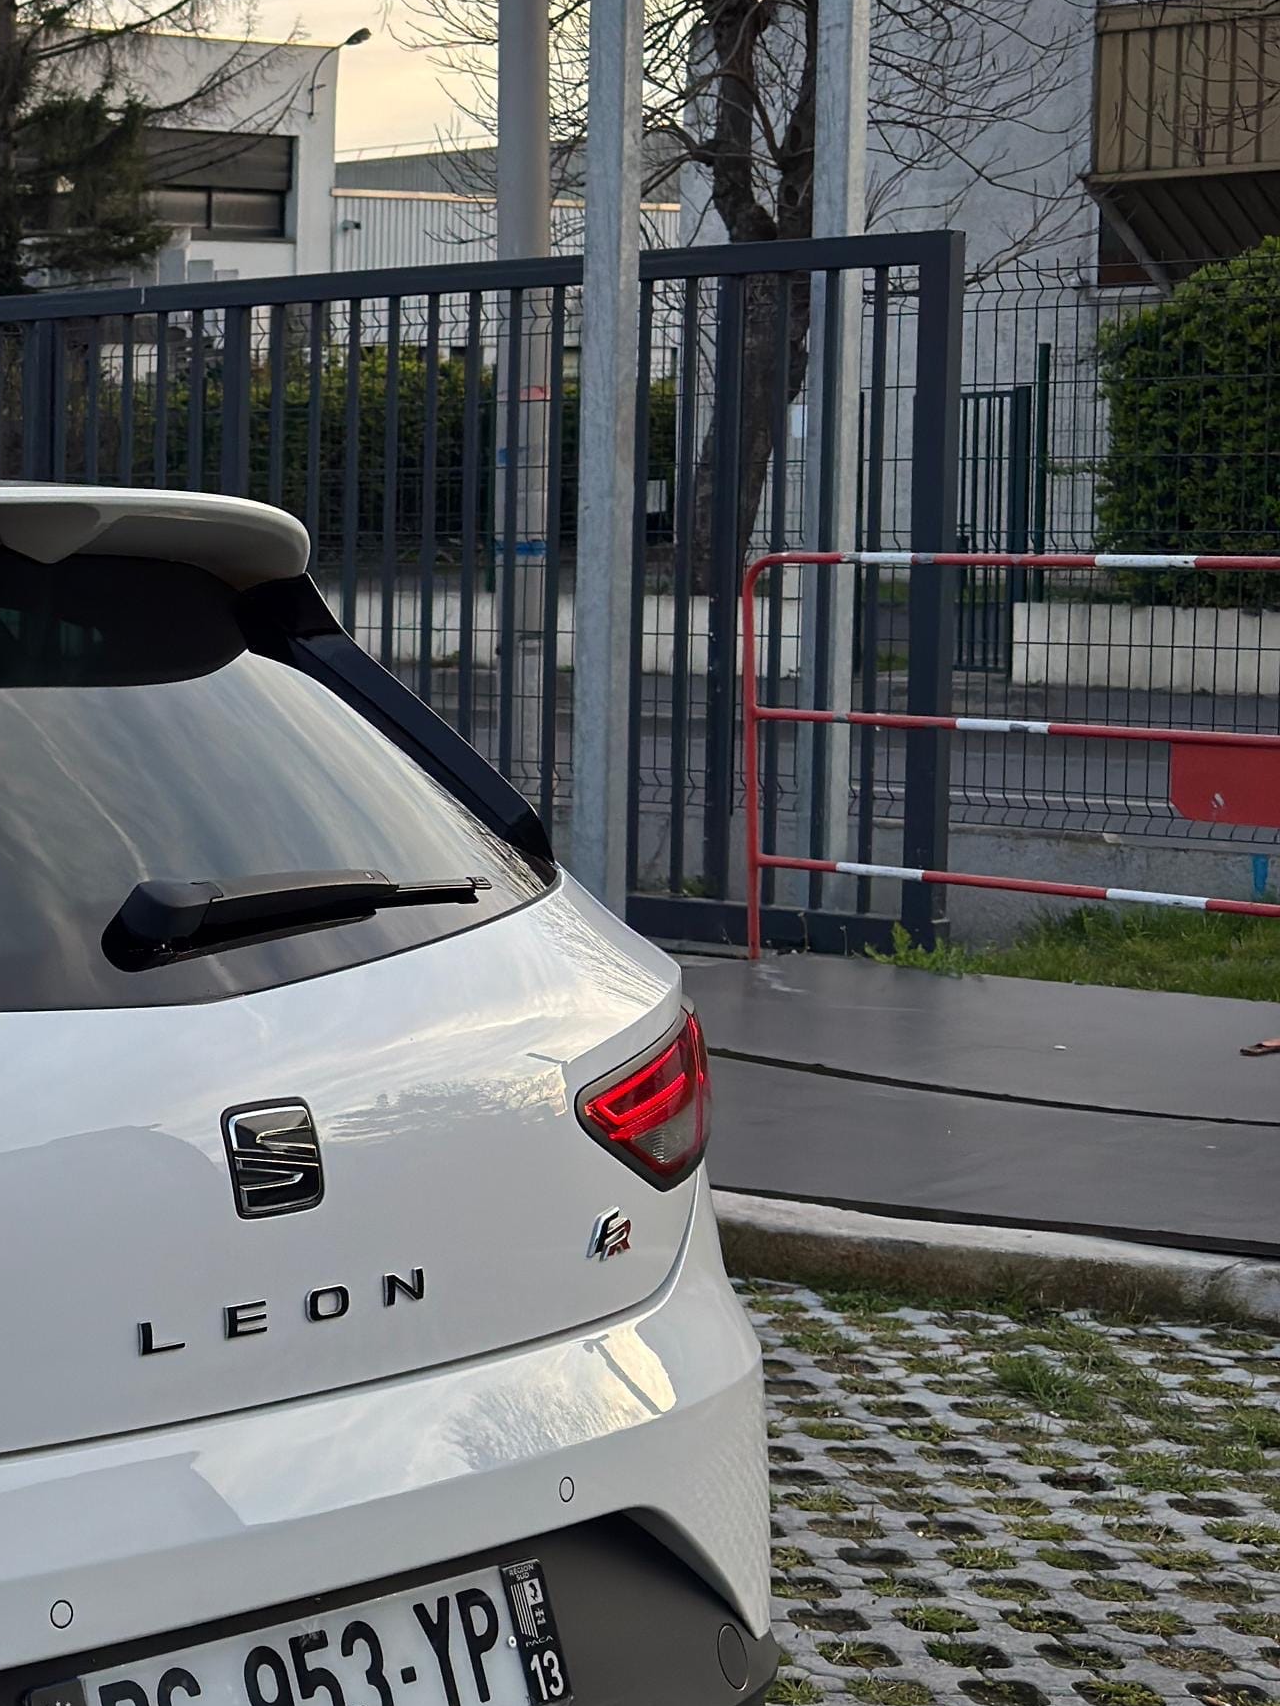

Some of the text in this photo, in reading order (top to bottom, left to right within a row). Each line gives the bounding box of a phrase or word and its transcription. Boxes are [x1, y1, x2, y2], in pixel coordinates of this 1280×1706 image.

[137, 1266, 425, 1356] LEON
[525, 1635, 554, 1647] PACA
[530, 1650, 564, 1701] 13
